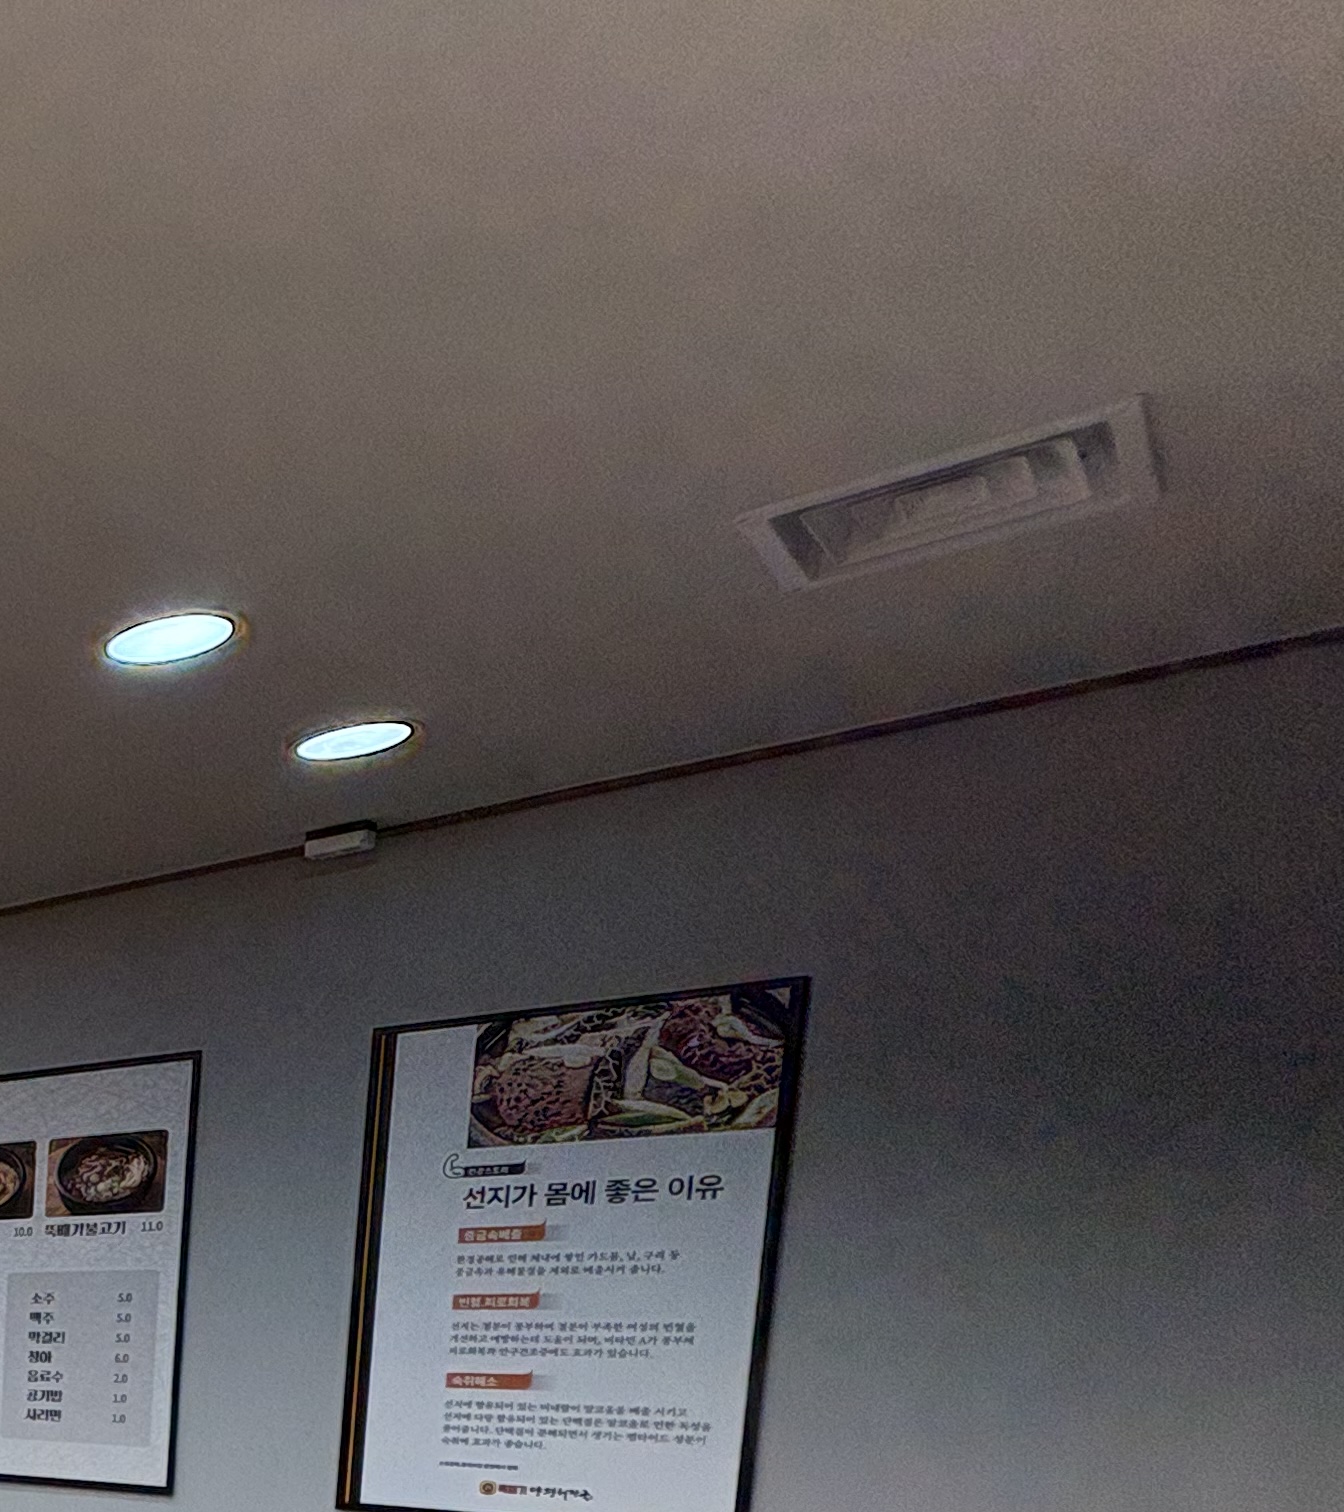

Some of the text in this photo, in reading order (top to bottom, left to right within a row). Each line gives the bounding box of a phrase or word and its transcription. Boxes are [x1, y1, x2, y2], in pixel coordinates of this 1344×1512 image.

[463, 1174, 725, 1209] 선지가 몸에 좋은 이유
[30, 1292, 133, 1305] 소주 5.0
[29, 1311, 132, 1325] 맥주 5.0
[28, 1331, 131, 1345] 막걸리 5.0
[114, 1353, 129, 1363] 6.0
[27, 1370, 128, 1384] 음료수 2.0
[26, 1389, 127, 1404] 공기밥 1.0
[112, 1414, 126, 1424] 1.0
